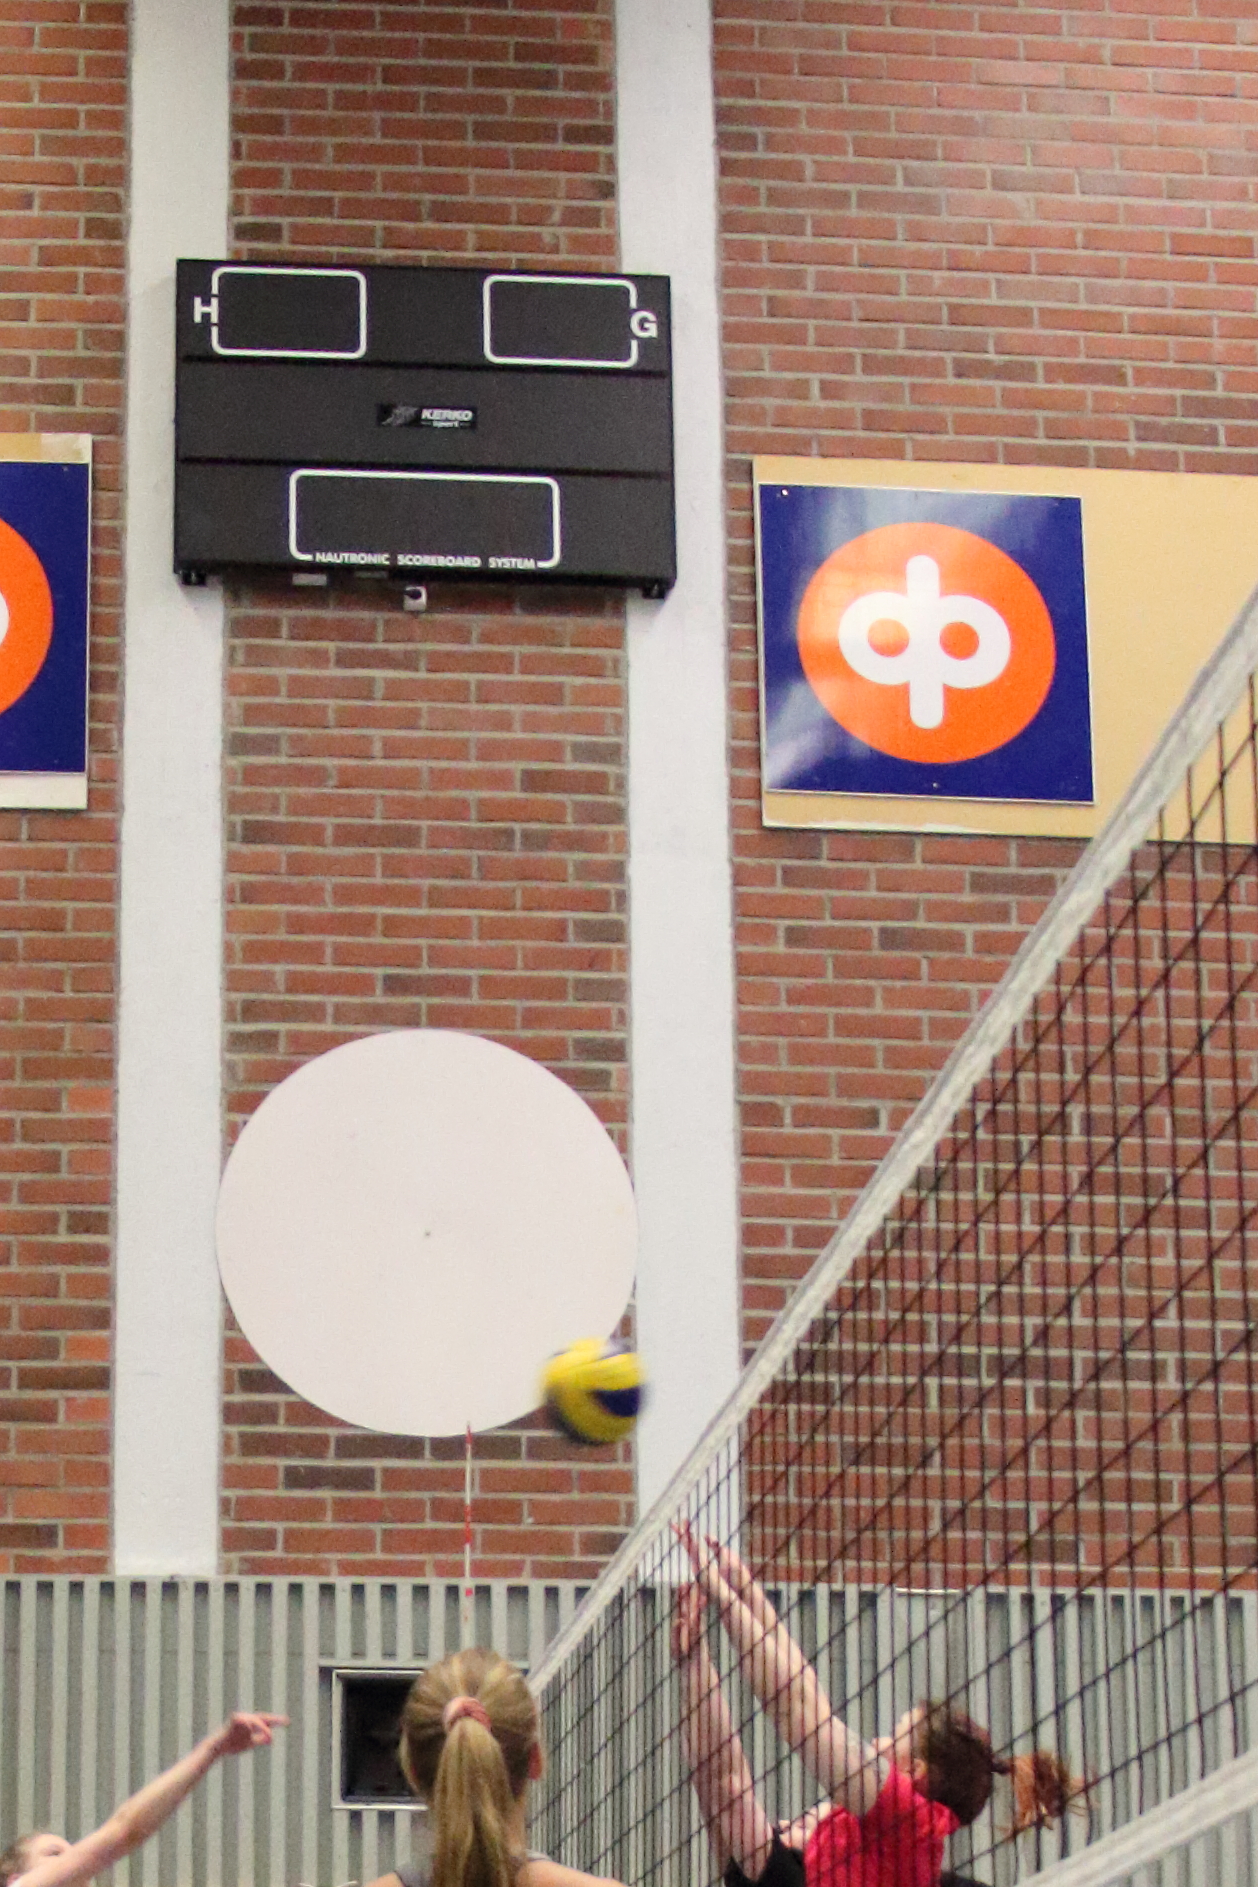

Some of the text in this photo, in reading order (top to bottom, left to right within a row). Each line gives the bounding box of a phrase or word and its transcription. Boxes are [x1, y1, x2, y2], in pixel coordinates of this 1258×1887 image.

[194, 296, 219, 323] H
[630, 310, 658, 339] G
[315, 551, 535, 569] NAUTRONIC SCOREBOARD SYSTEM
